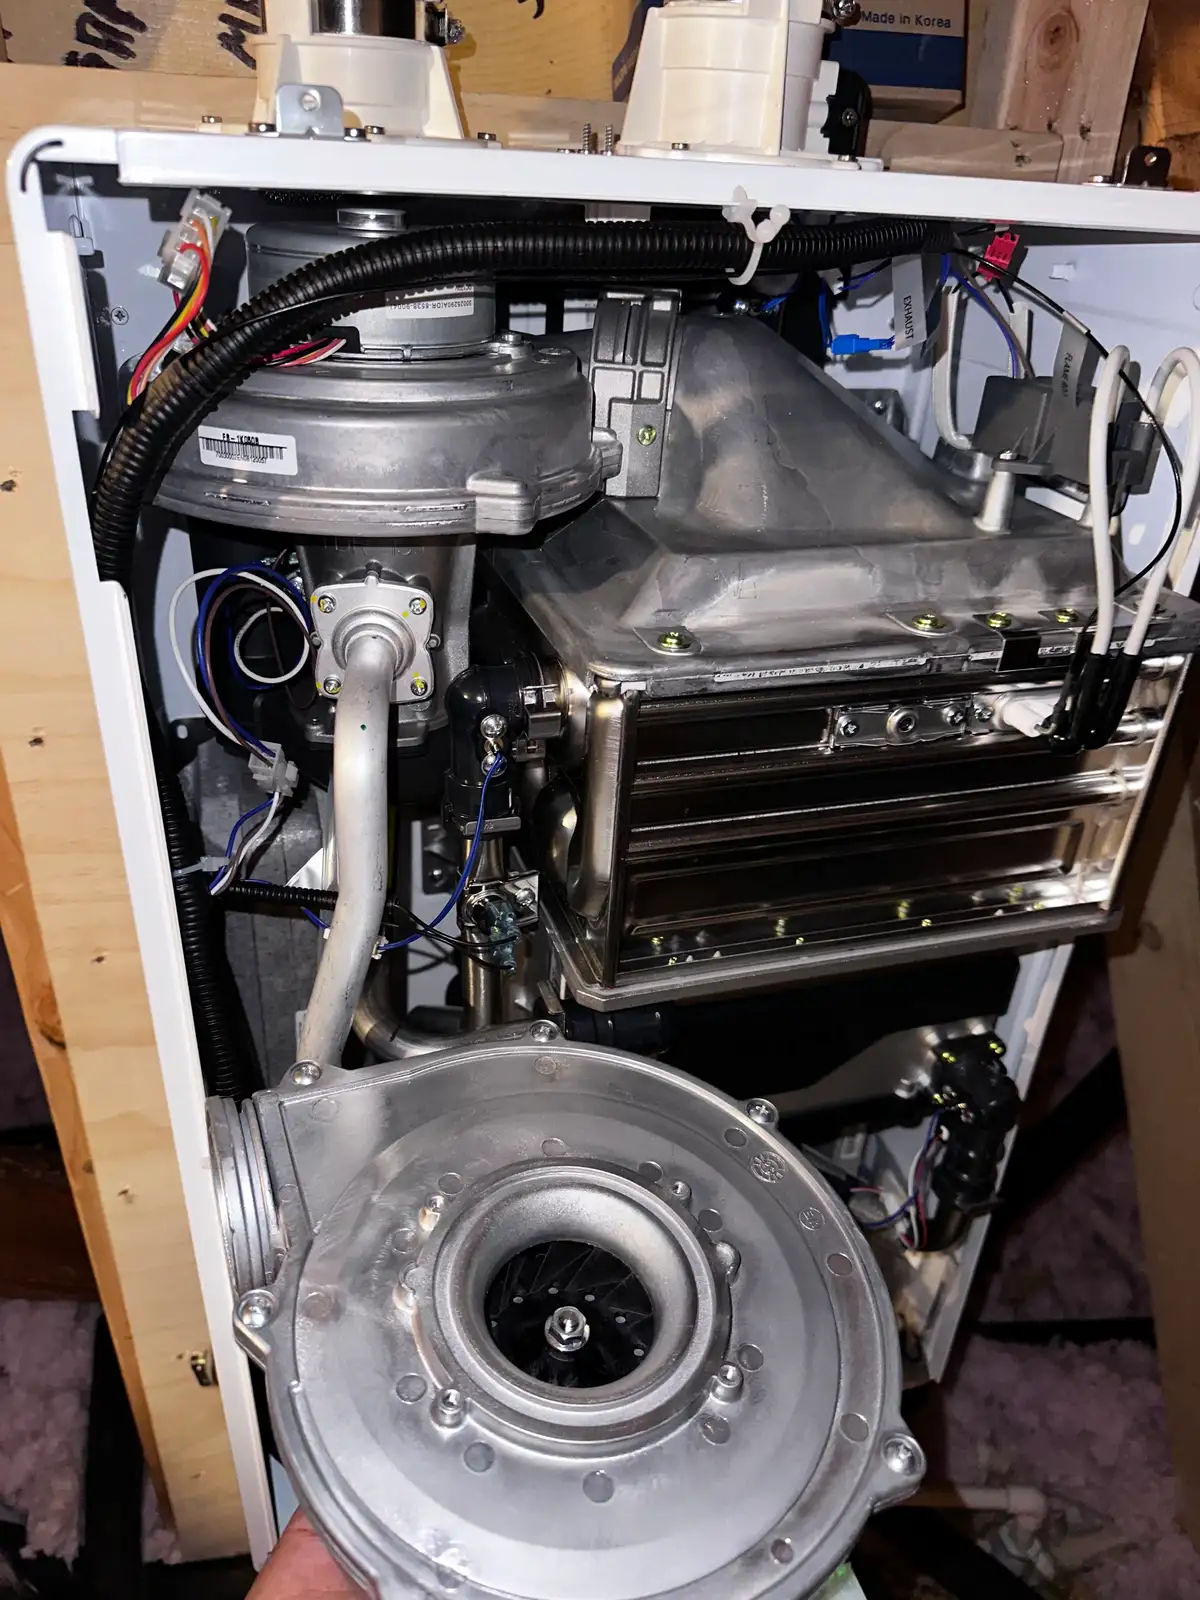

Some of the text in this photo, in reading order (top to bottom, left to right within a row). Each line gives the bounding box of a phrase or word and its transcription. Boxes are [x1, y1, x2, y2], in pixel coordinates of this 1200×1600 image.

[860, 10, 951, 29] Made in Korea
[903, 295, 914, 340] EXHAUST
